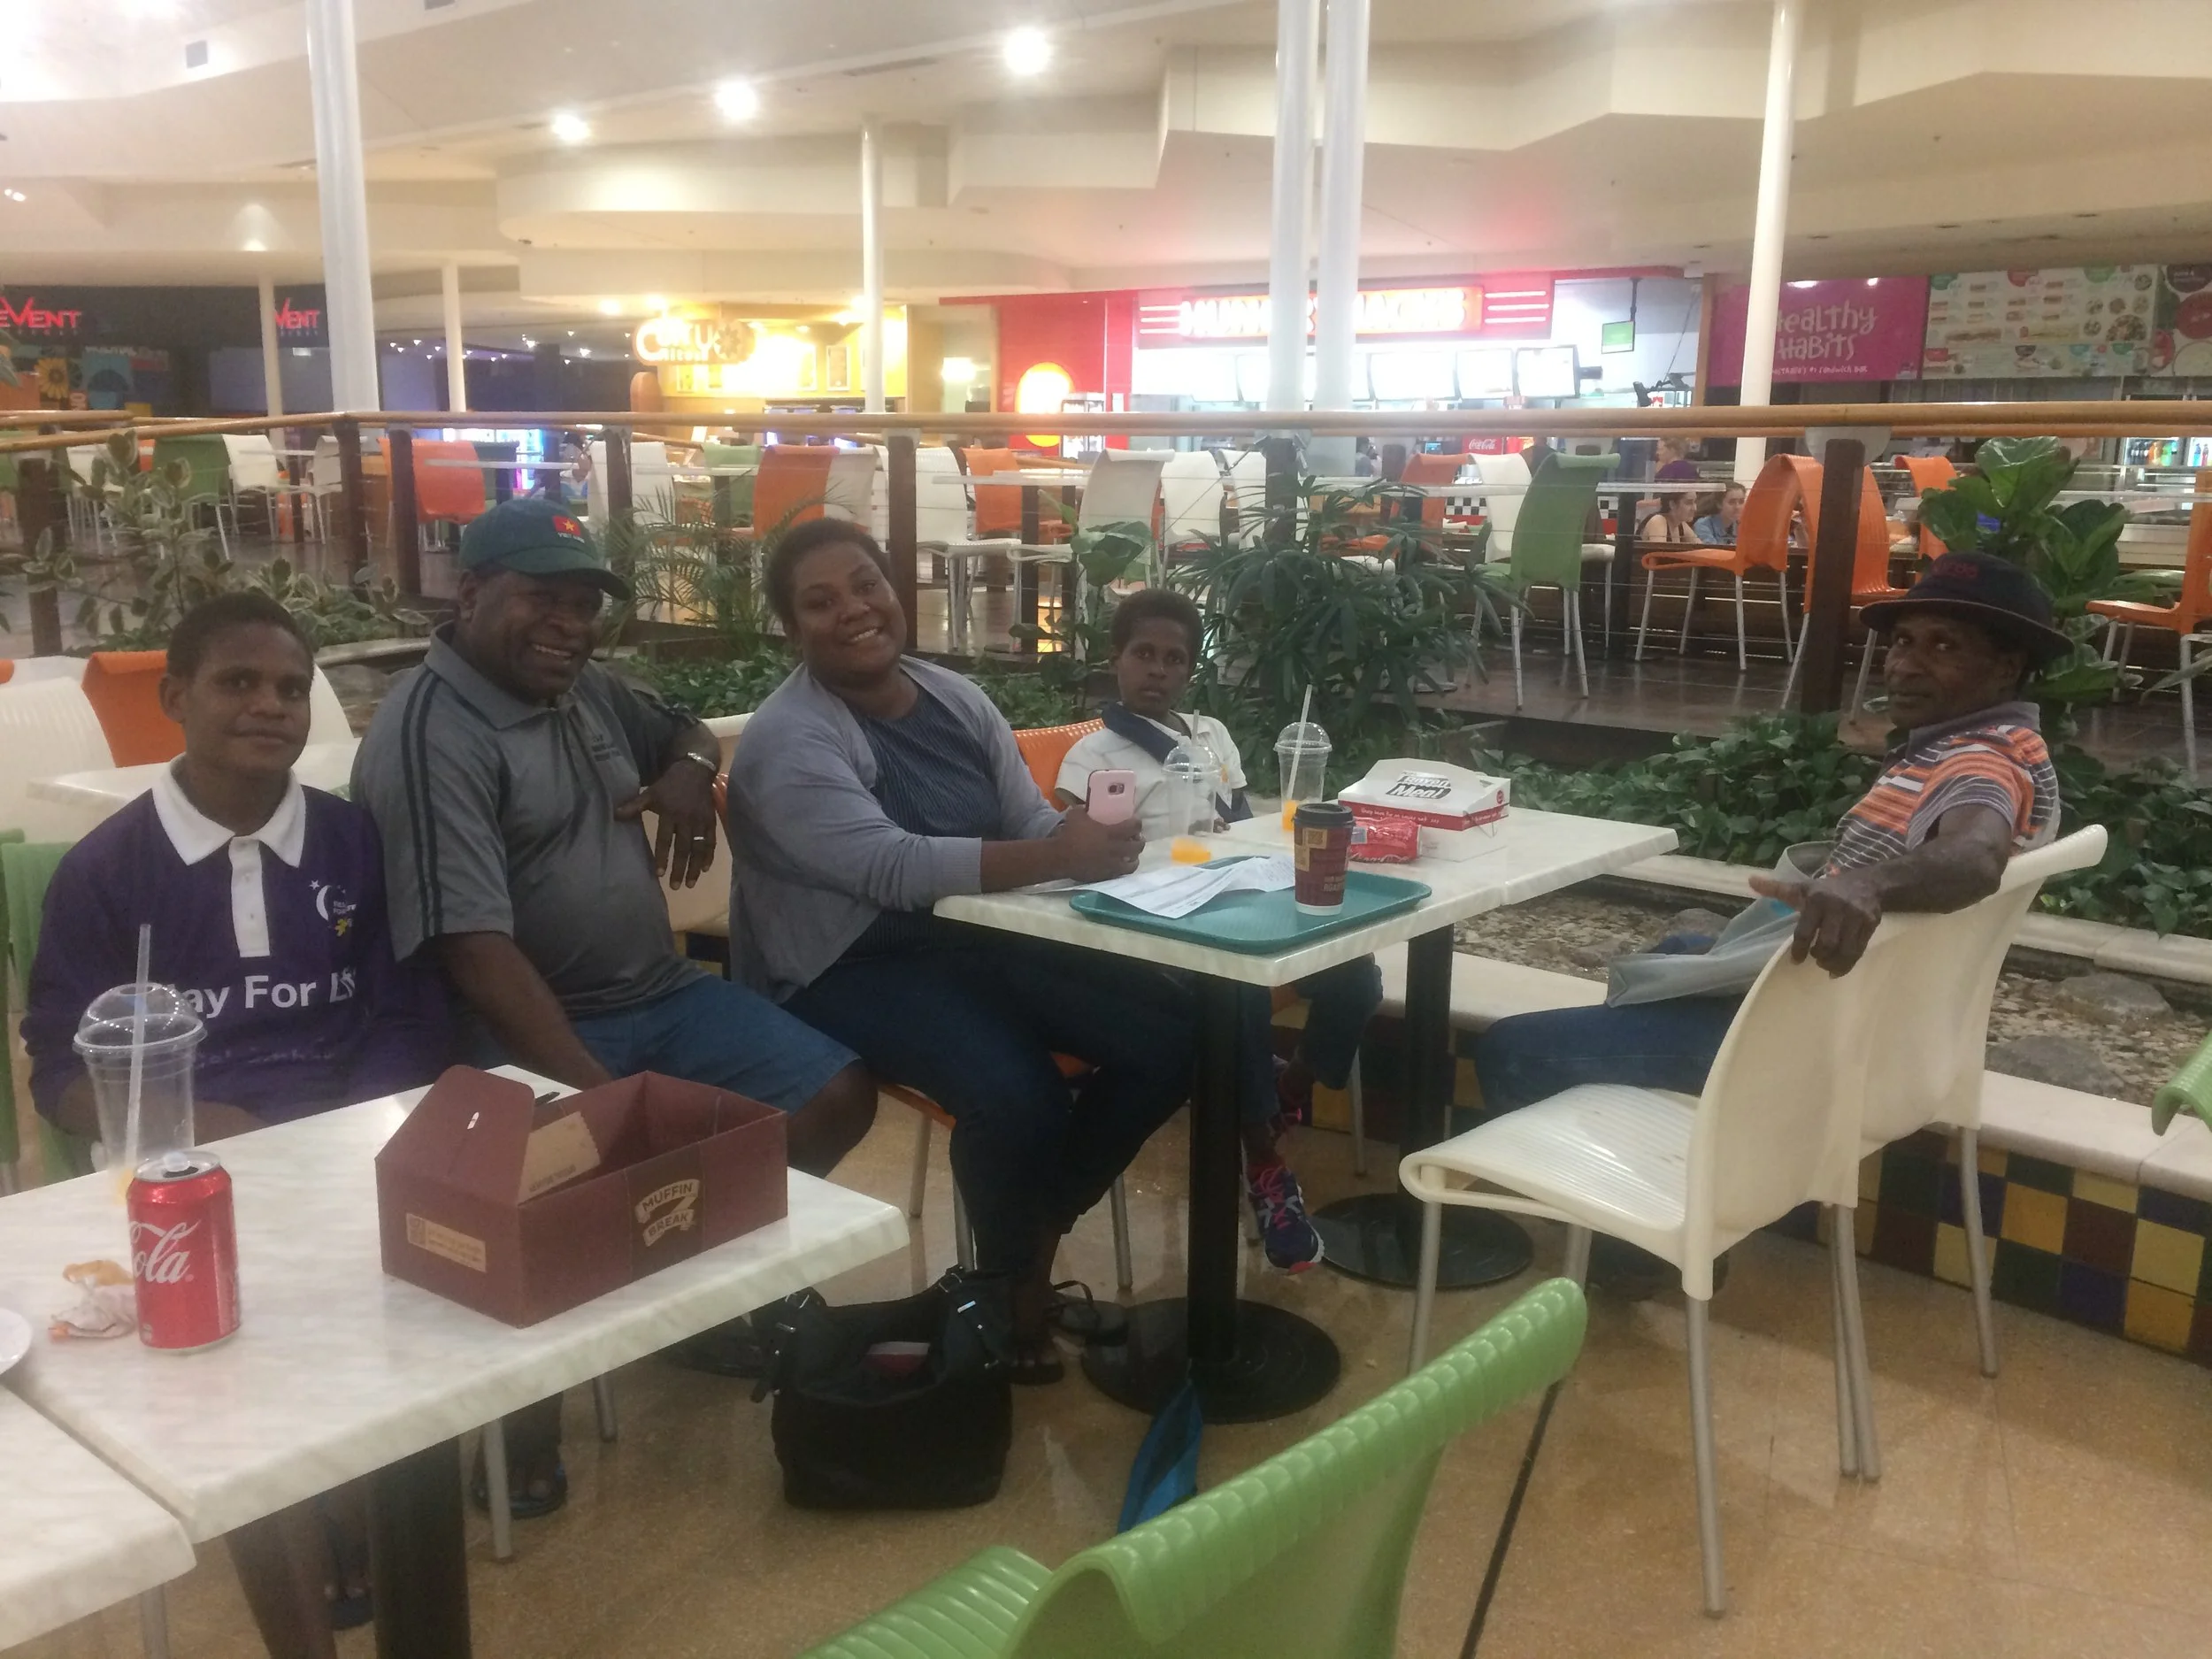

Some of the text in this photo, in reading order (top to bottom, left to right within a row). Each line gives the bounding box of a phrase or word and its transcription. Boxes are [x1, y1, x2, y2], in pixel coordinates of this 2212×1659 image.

[274, 297, 319, 329] VENT
[1392, 784, 1444, 799] Meal
[244, 975, 317, 1008] For
[641, 1181, 694, 1212] MUFFIN
[648, 1212, 687, 1236] BREAK
